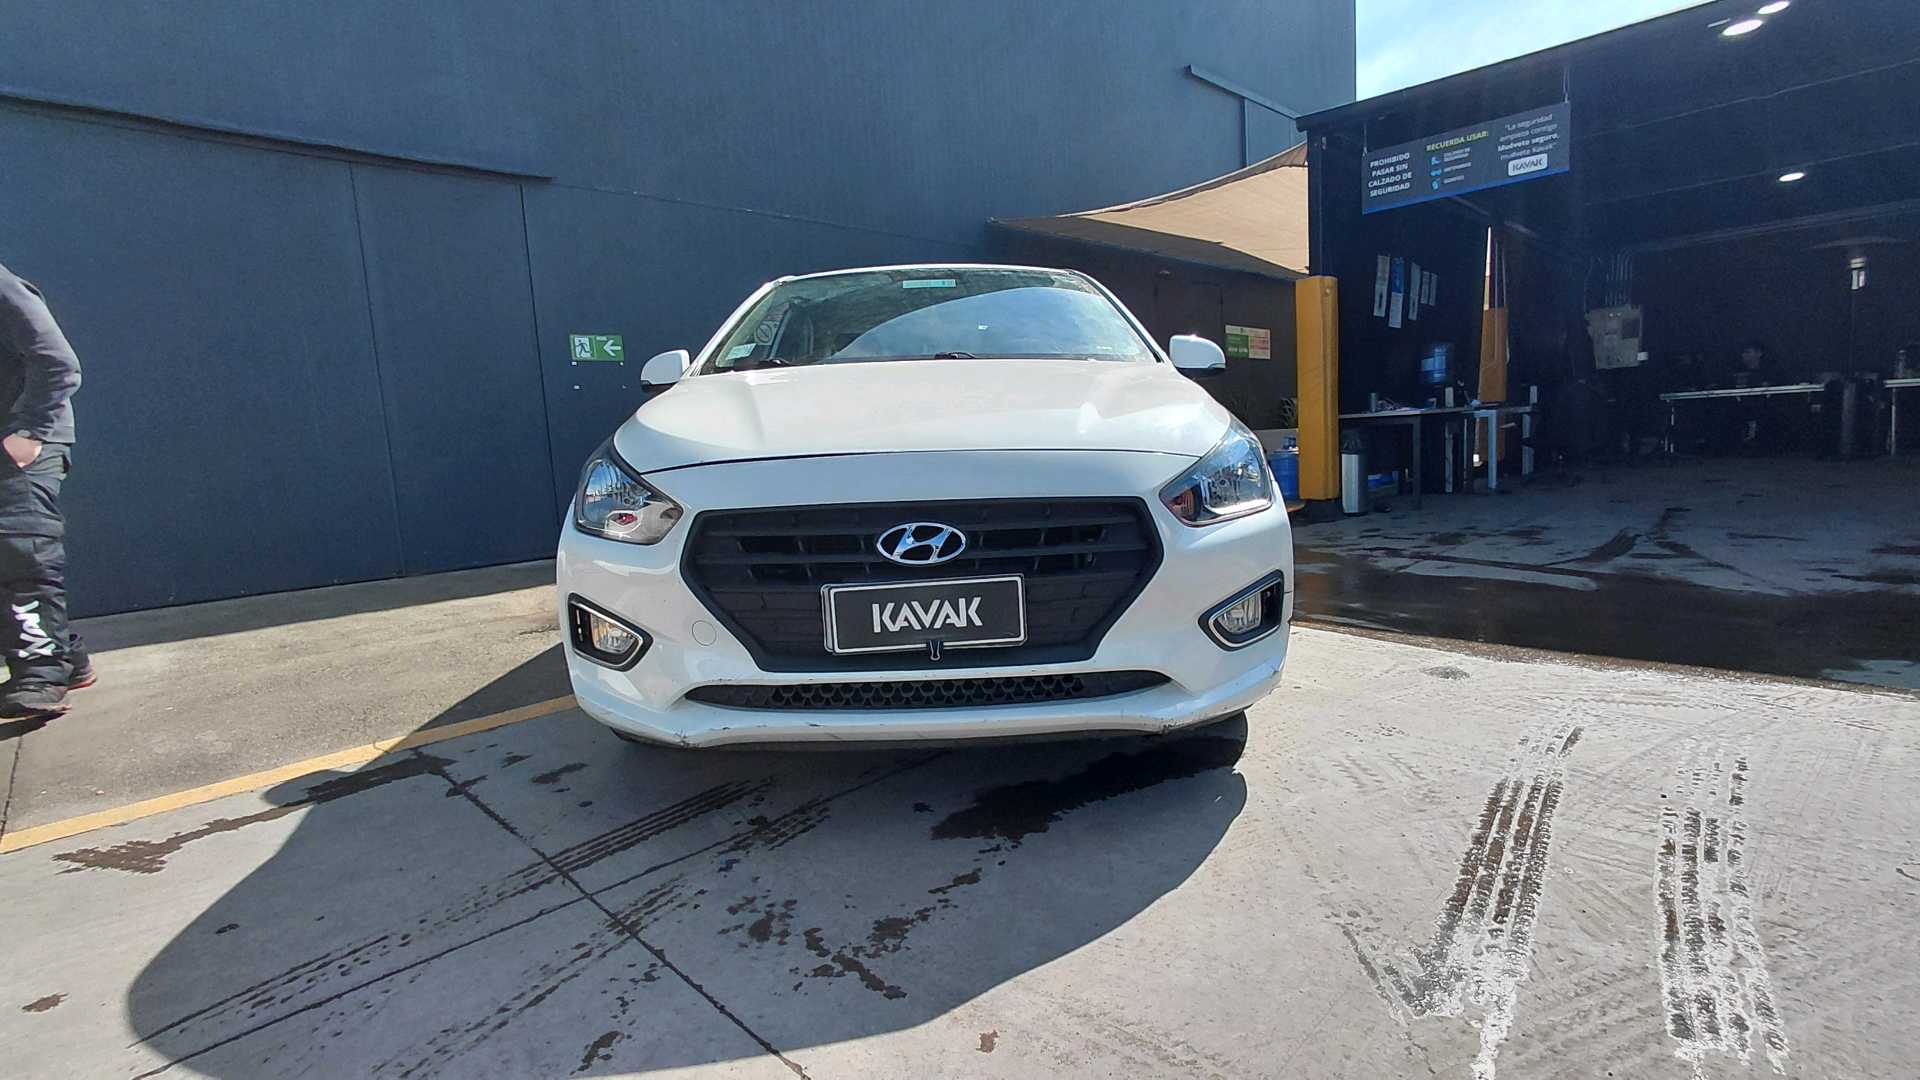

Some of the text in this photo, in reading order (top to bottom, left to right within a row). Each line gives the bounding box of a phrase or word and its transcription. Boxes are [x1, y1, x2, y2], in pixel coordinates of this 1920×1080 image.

[1426, 136, 1465, 151] RECUERDA
[1369, 152, 1411, 168] PROHIBIDO
[1512, 158, 1544, 172] KAVAK
[1371, 163, 1409, 177] PASAR SIN
[1368, 171, 1413, 187] CALZADO DE
[1369, 182, 1410, 197] SEGURIDAD
[872, 597, 983, 633] KAVAK
